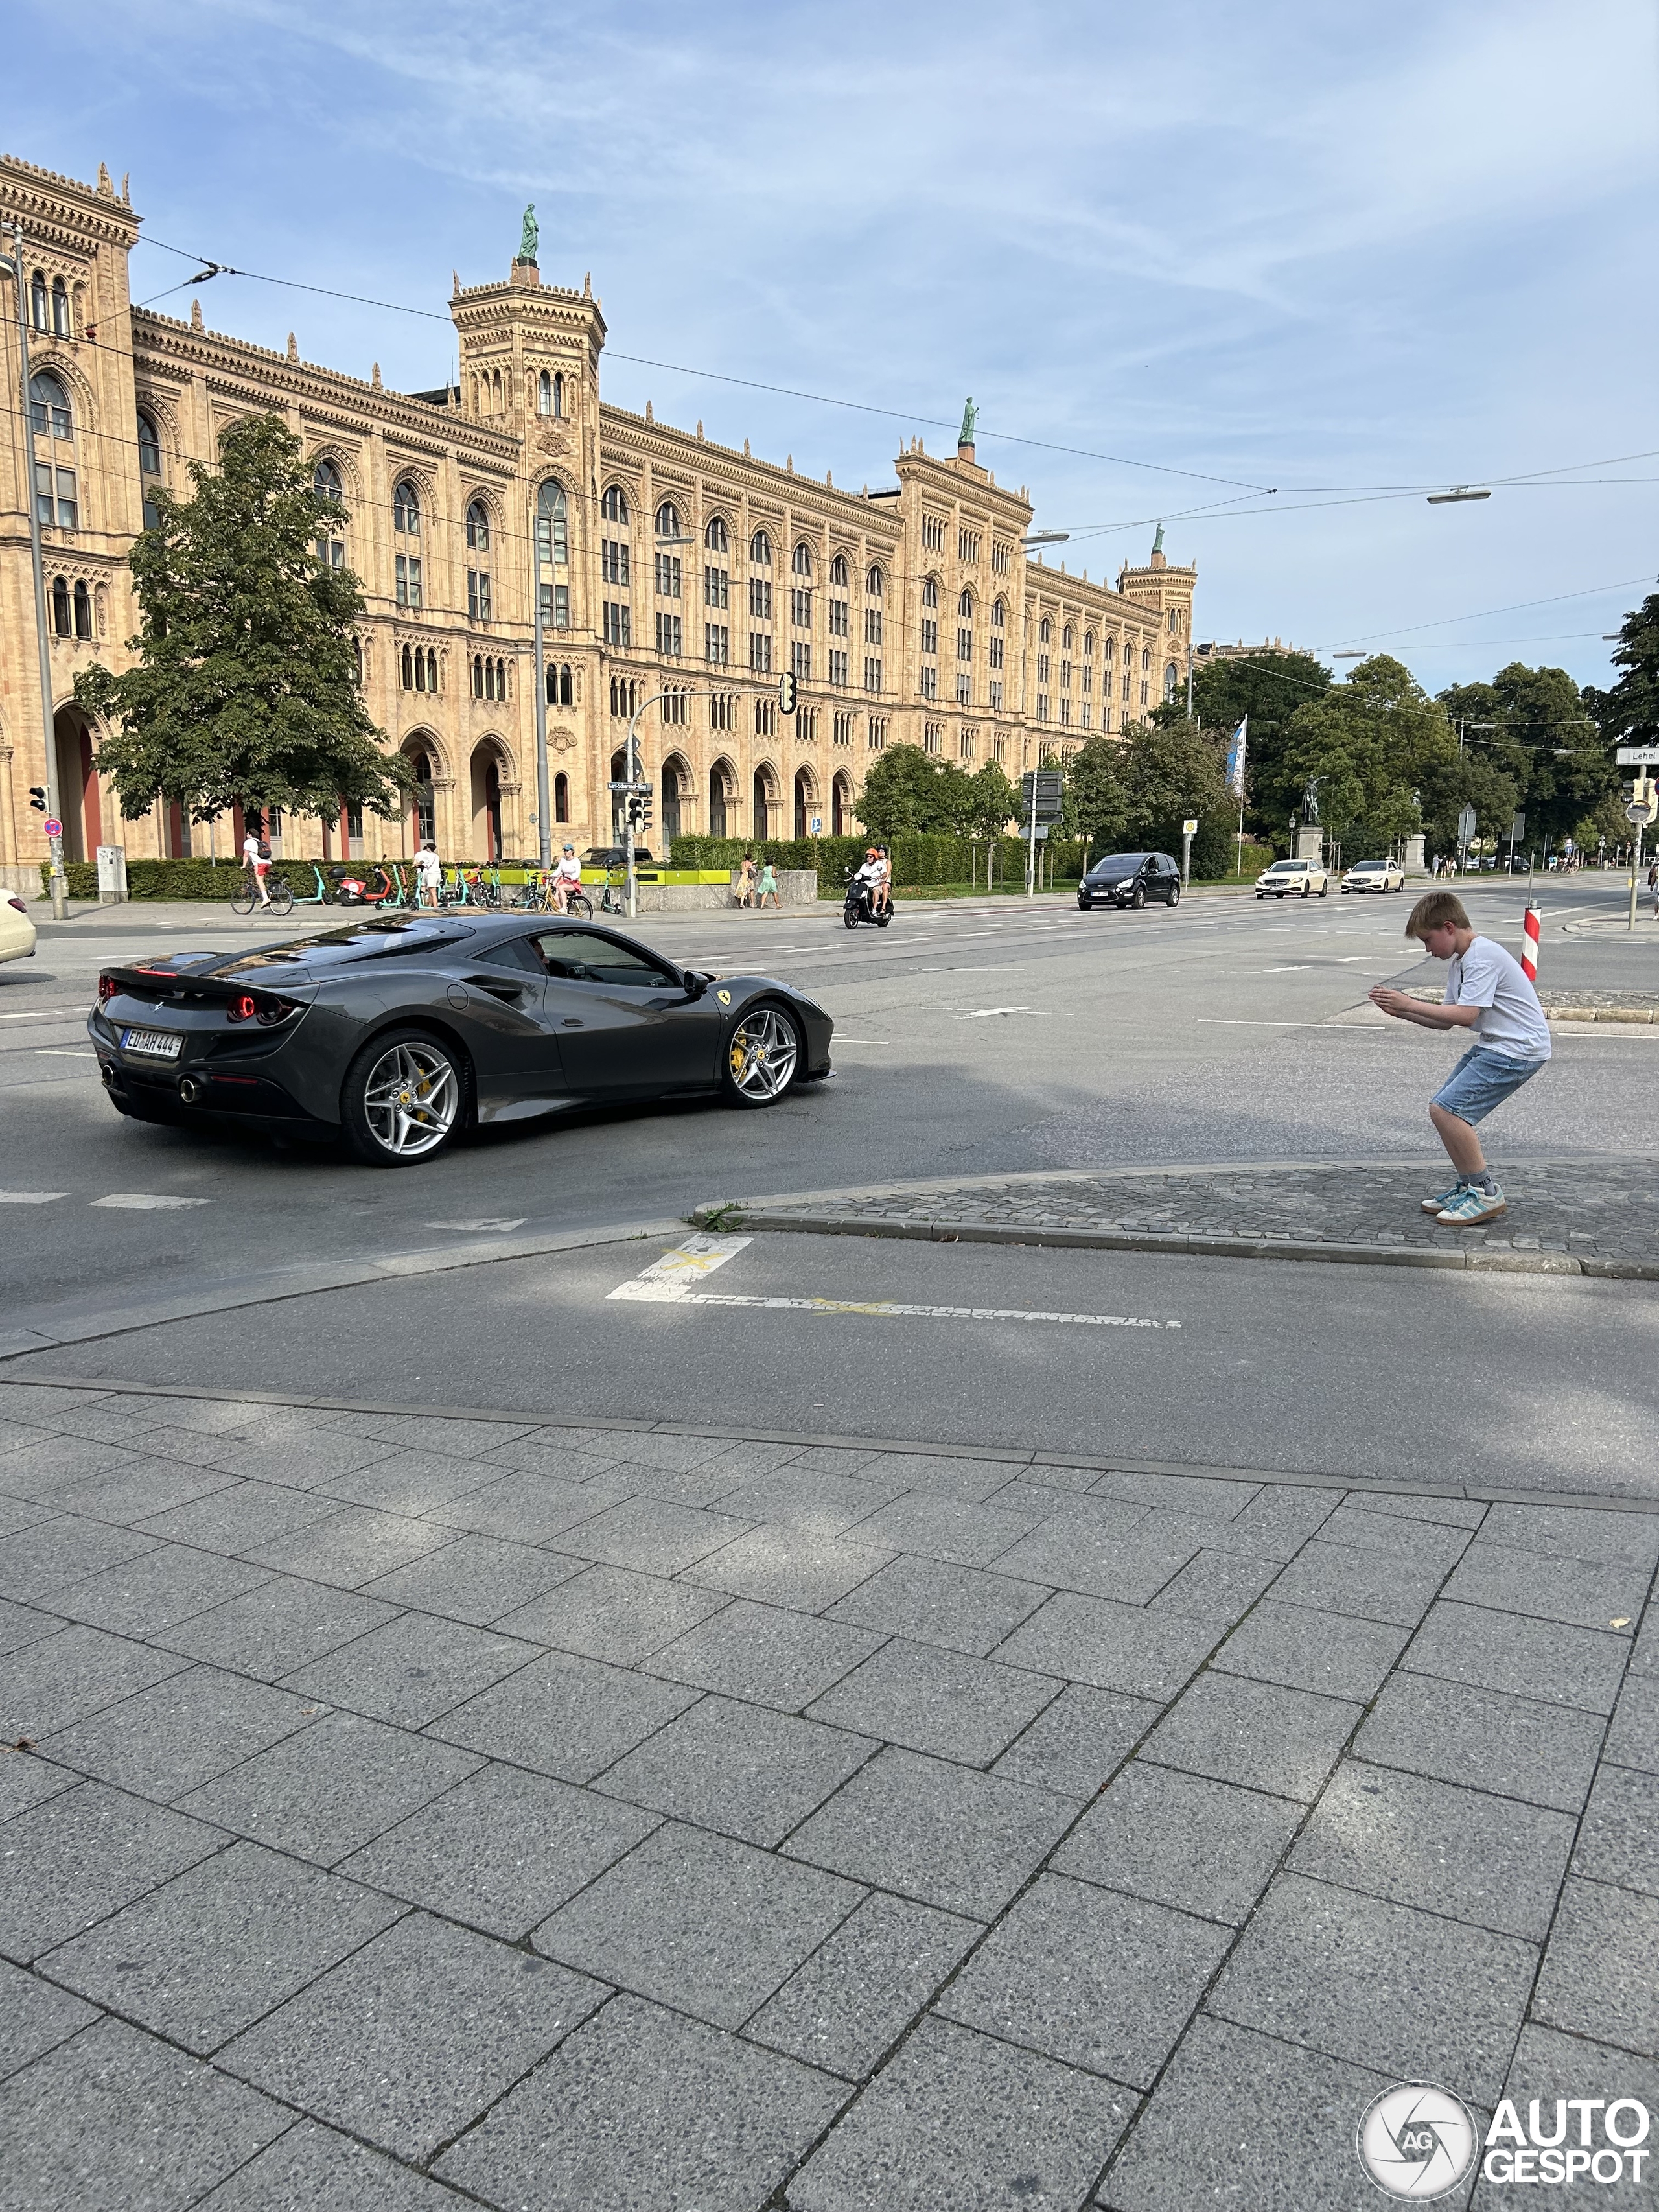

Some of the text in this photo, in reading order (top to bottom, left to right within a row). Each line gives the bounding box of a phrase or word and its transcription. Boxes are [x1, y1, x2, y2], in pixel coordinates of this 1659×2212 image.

[128, 1030, 141, 1047] ED
[143, 1034, 158, 1051] AH
[157, 1036, 175, 1053] 444
